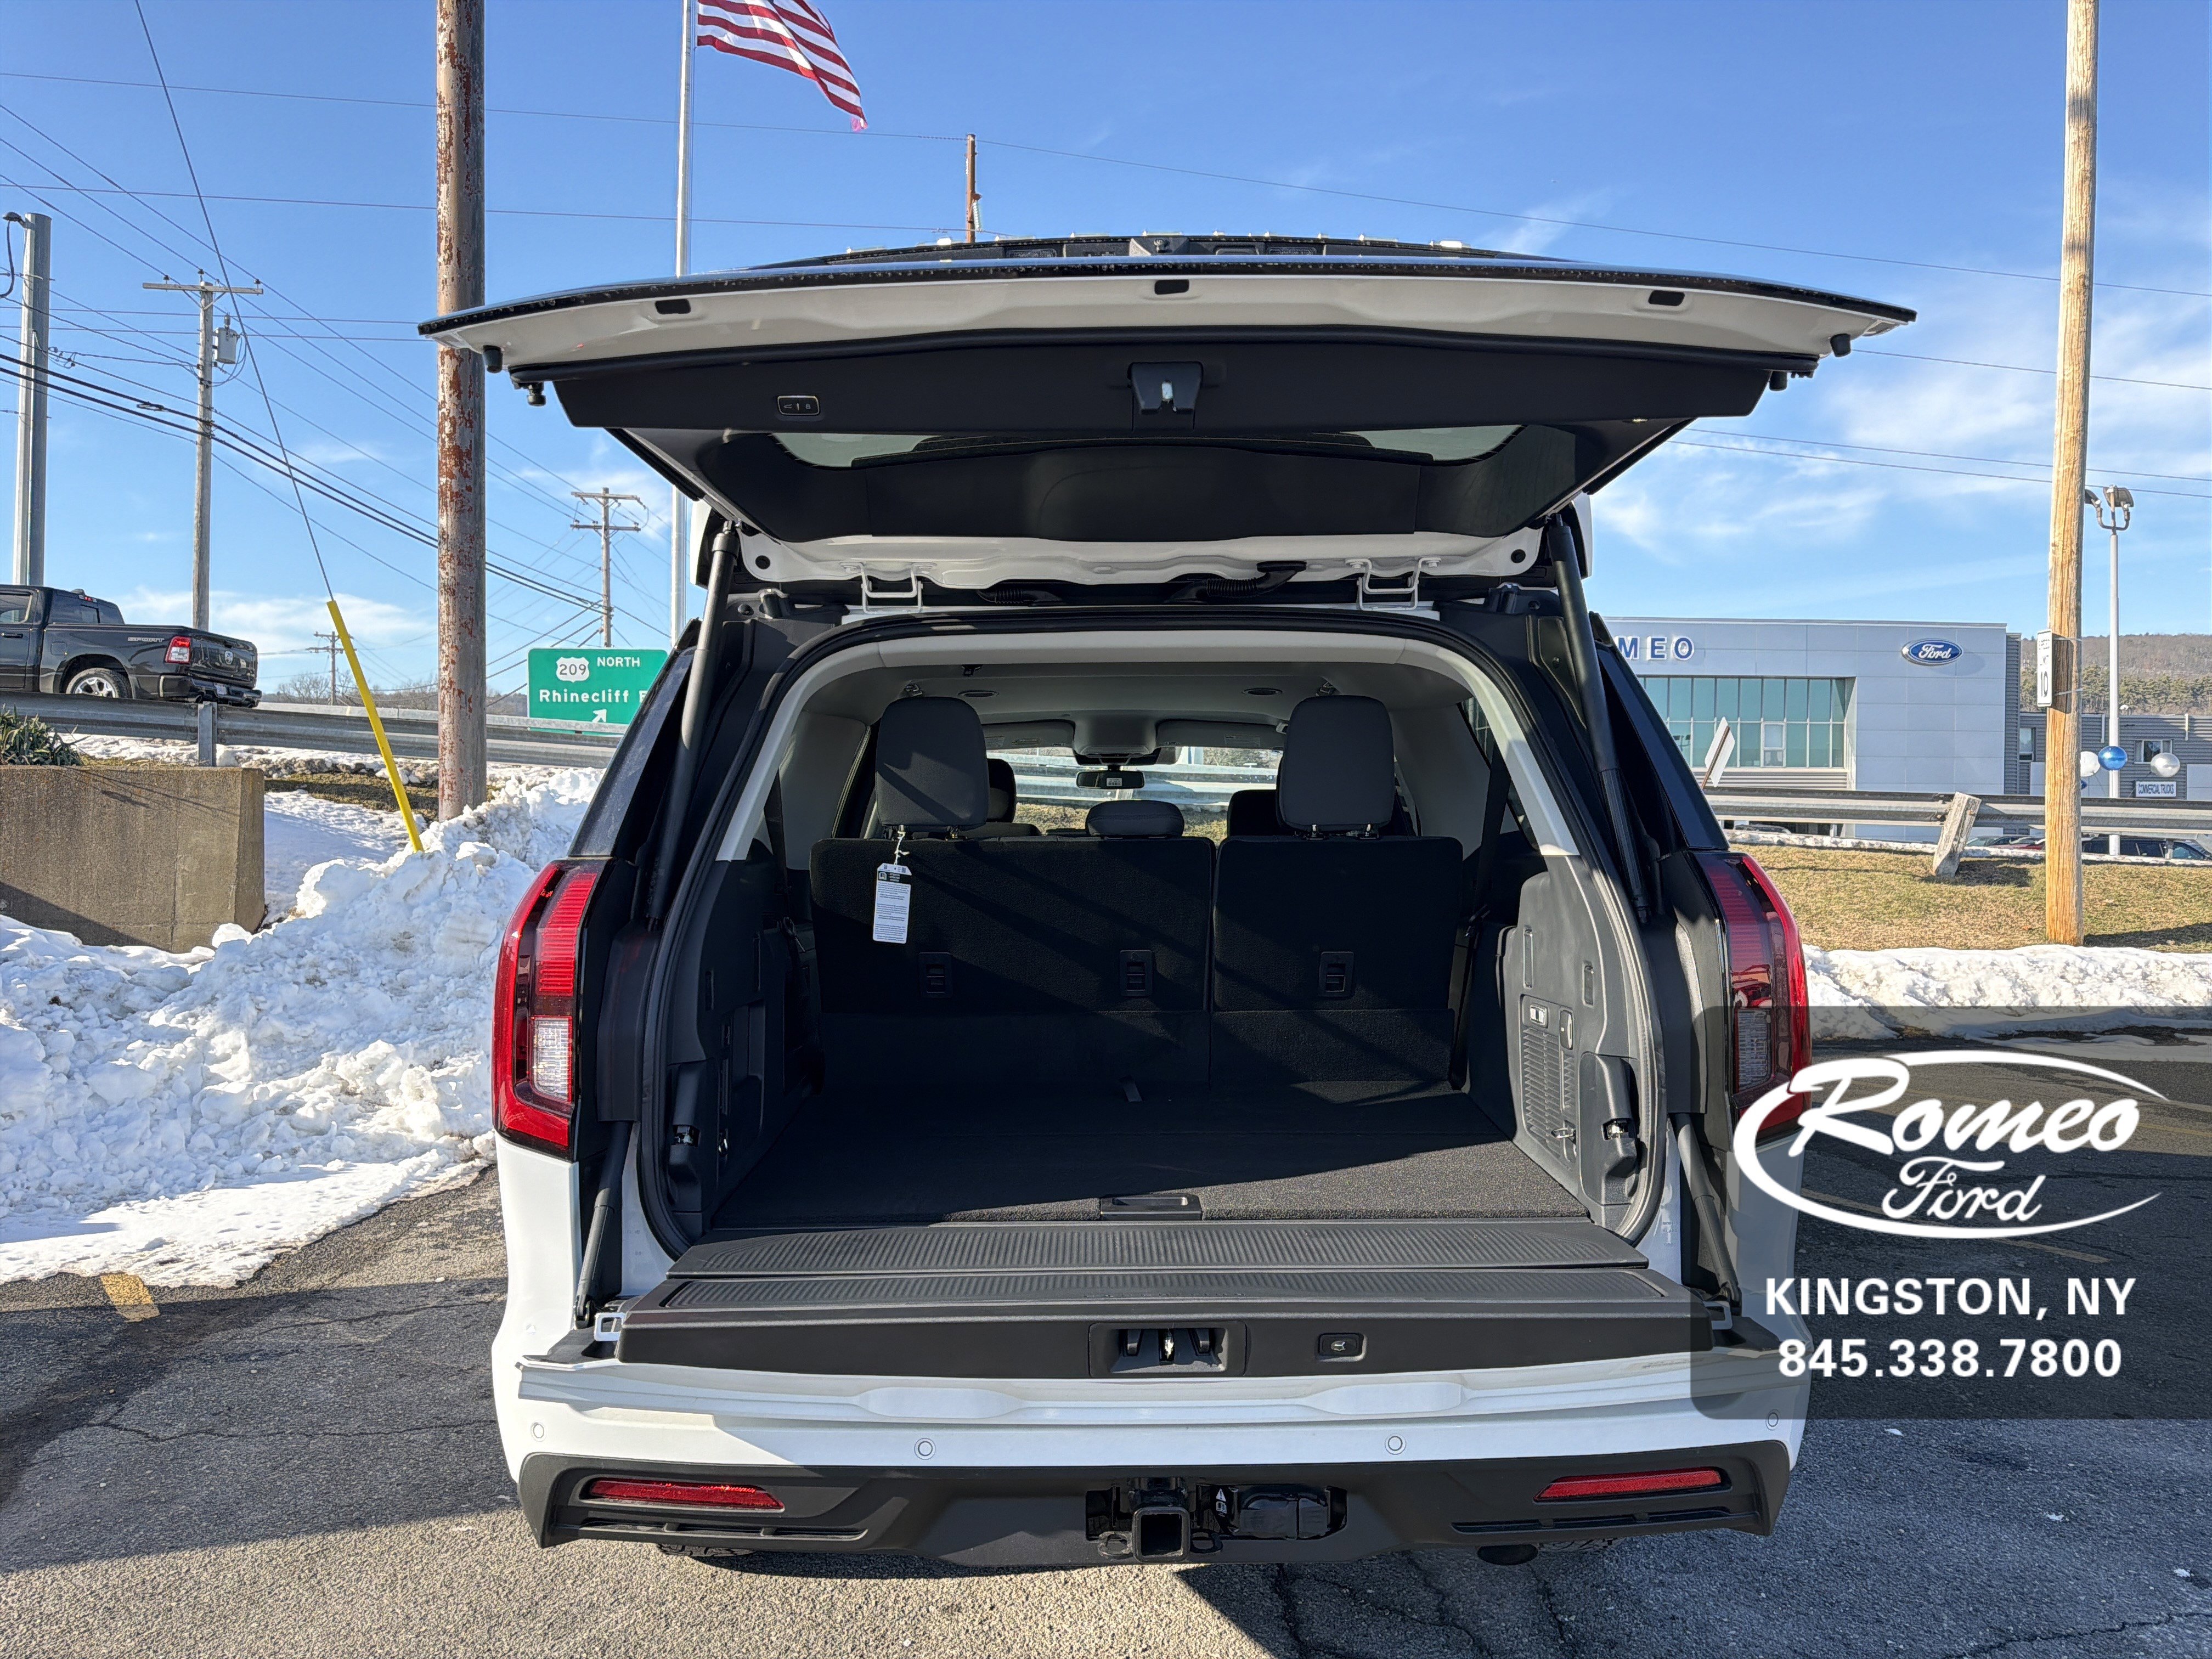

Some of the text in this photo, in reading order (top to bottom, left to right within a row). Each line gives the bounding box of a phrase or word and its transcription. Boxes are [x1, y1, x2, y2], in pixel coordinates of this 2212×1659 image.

[1918, 644, 1952, 659] Ford
[597, 657, 641, 667] NORTH
[559, 663, 586, 675] 209
[539, 689, 629, 703] Rhinecliff
